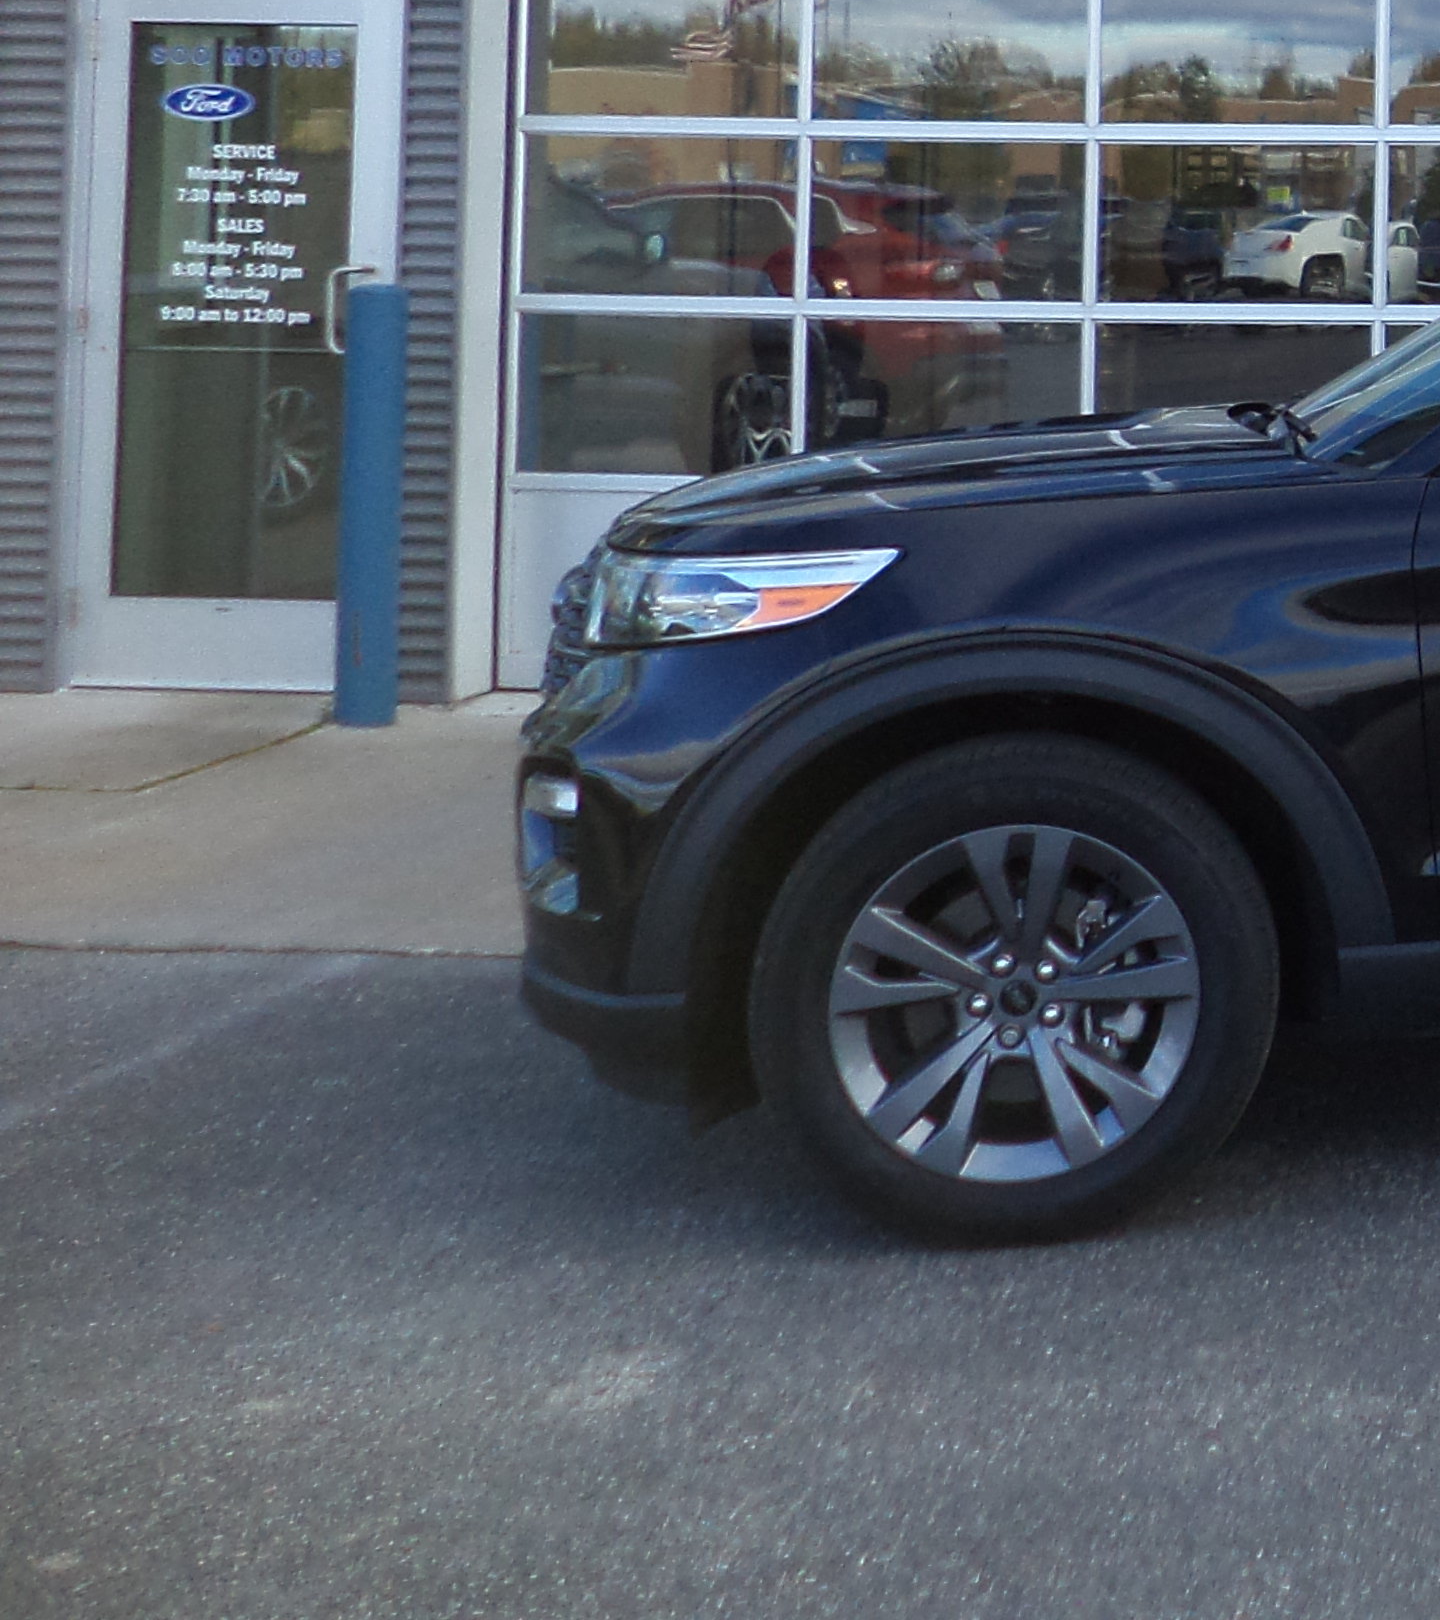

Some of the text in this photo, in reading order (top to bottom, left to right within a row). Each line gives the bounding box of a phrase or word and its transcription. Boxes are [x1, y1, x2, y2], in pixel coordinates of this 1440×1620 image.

[151, 45, 344, 68] SOO MOTORS
[180, 88, 236, 113] Ford
[212, 144, 276, 159] SERVICE
[185, 166, 246, 184] Monday
[256, 167, 299, 185] Friday
[177, 188, 210, 203] 7:30
[213, 192, 236, 203] am
[248, 189, 281, 204] 5:00
[283, 193, 306, 207] pm
[217, 218, 264, 233] SALES
[183, 240, 242, 258] Monday
[252, 241, 296, 259] Friday
[209, 266, 233, 277] am
[245, 264, 278, 278] 5:30
[279, 267, 303, 281] pm
[204, 285, 270, 304] Saturday
[197, 309, 221, 321] am
[224, 308, 239, 322] to
[243, 308, 286, 323] 12:00
[288, 311, 311, 326] pm
